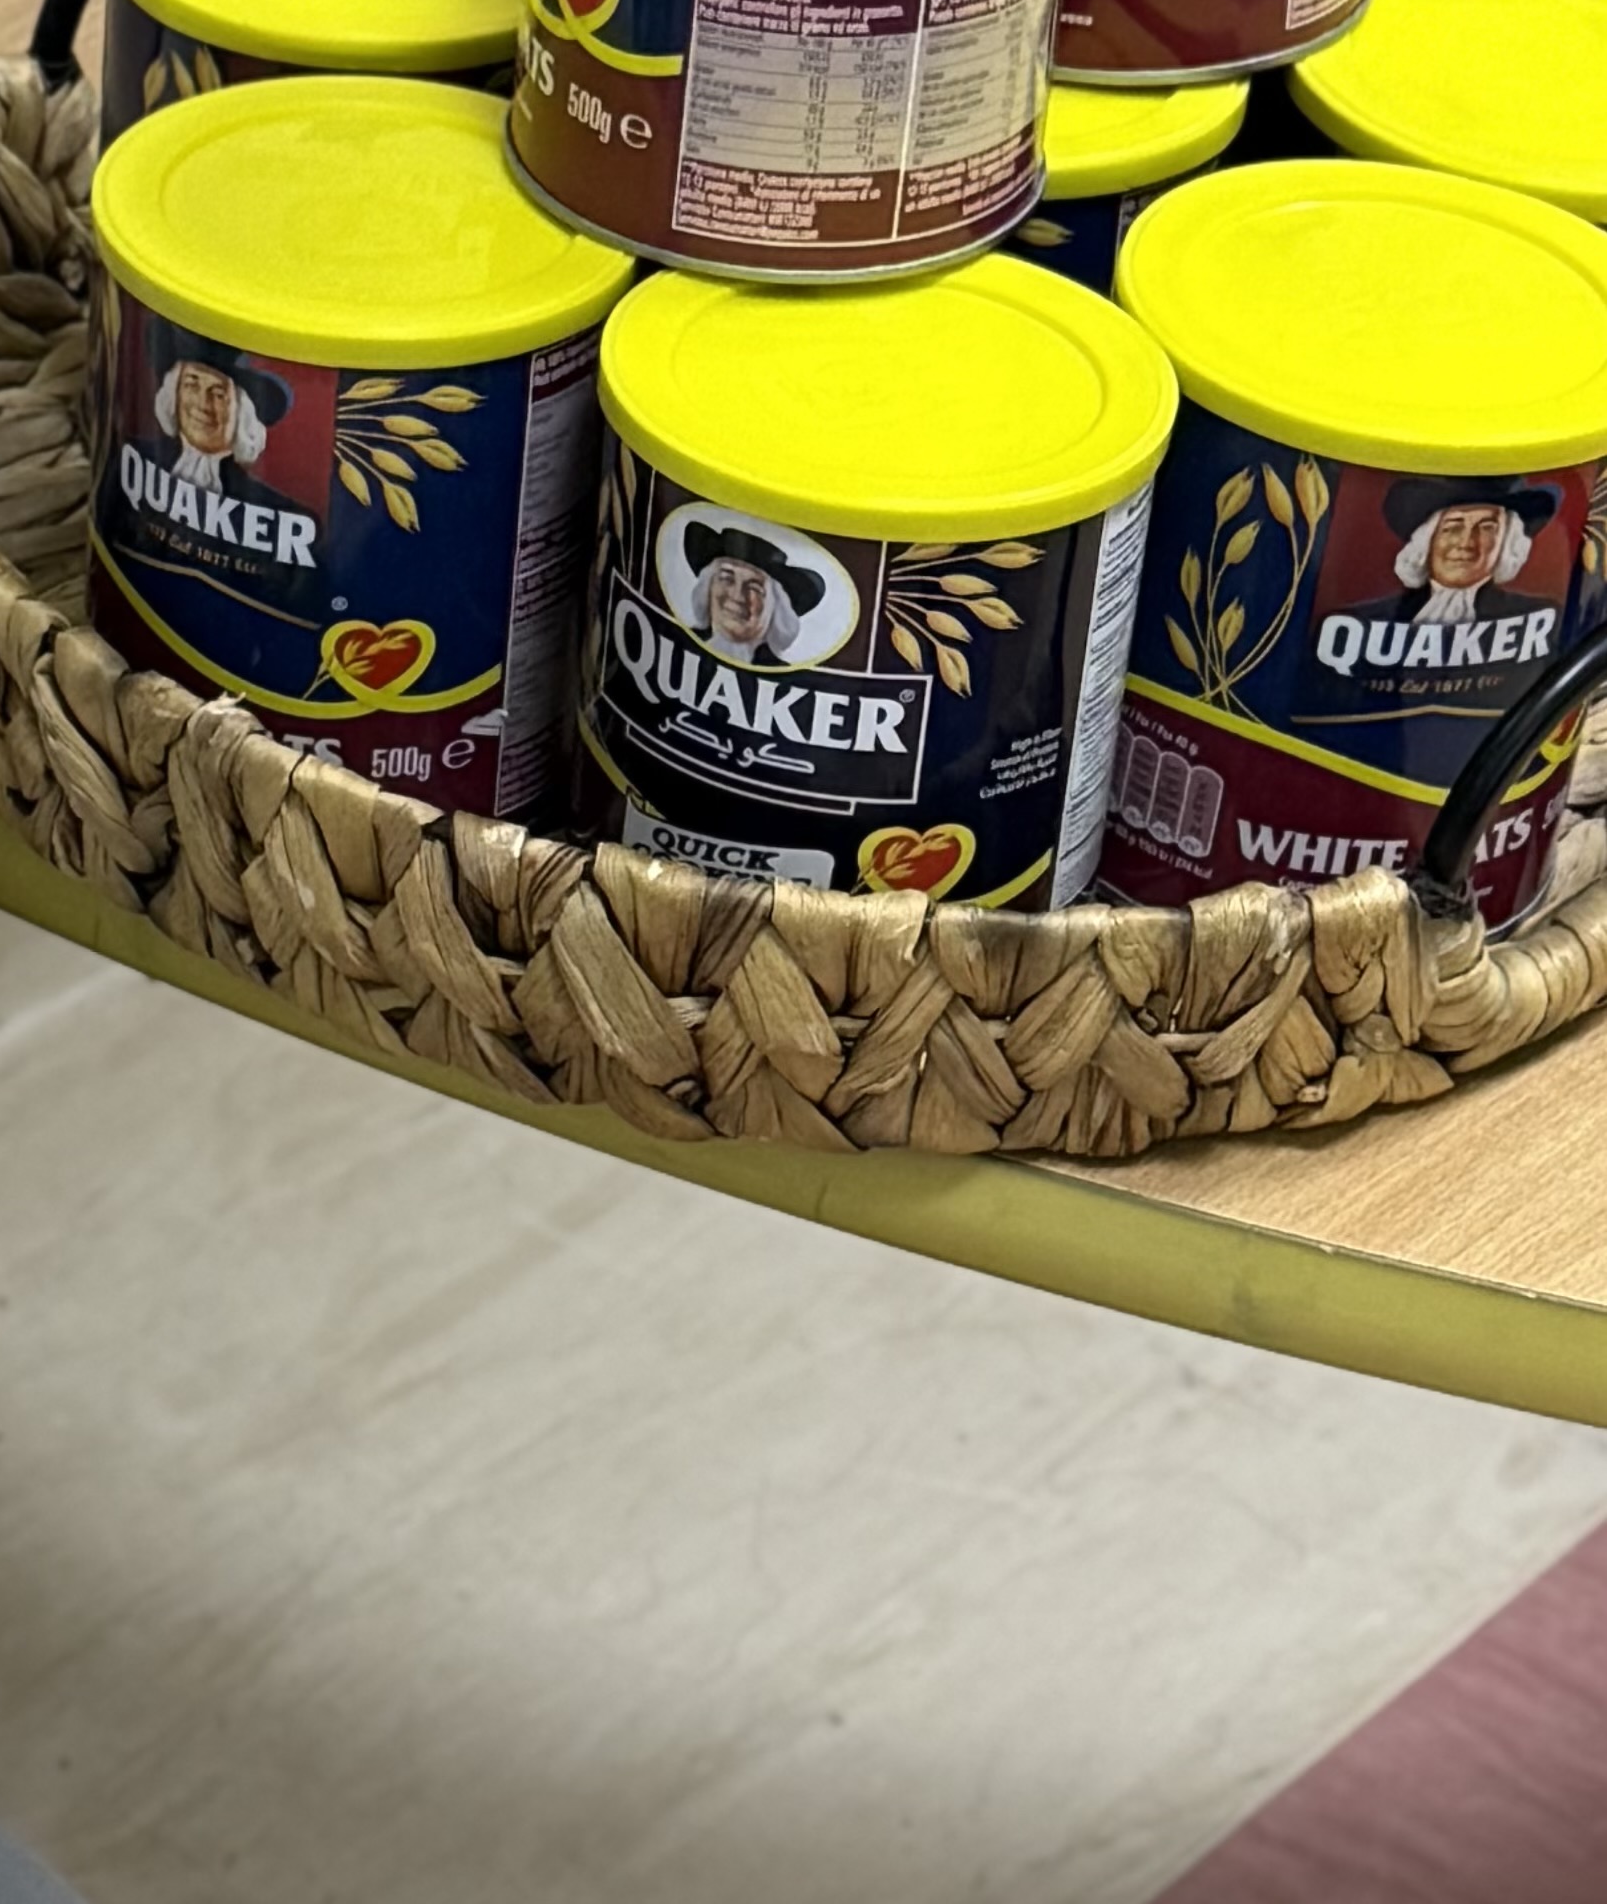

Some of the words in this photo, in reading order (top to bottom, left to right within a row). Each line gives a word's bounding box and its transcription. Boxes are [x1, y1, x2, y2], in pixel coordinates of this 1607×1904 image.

[567, 82, 611, 144] 500g
[121, 444, 317, 568] QUAKER
[1317, 608, 1556, 677] QUAKER
[614, 599, 908, 753] QUAKER
[371, 747, 431, 782] 500g
[659, 711, 815, 774] كويكر
[652, 827, 780, 871] QUICK
[1237, 818, 1409, 876] WHITE
